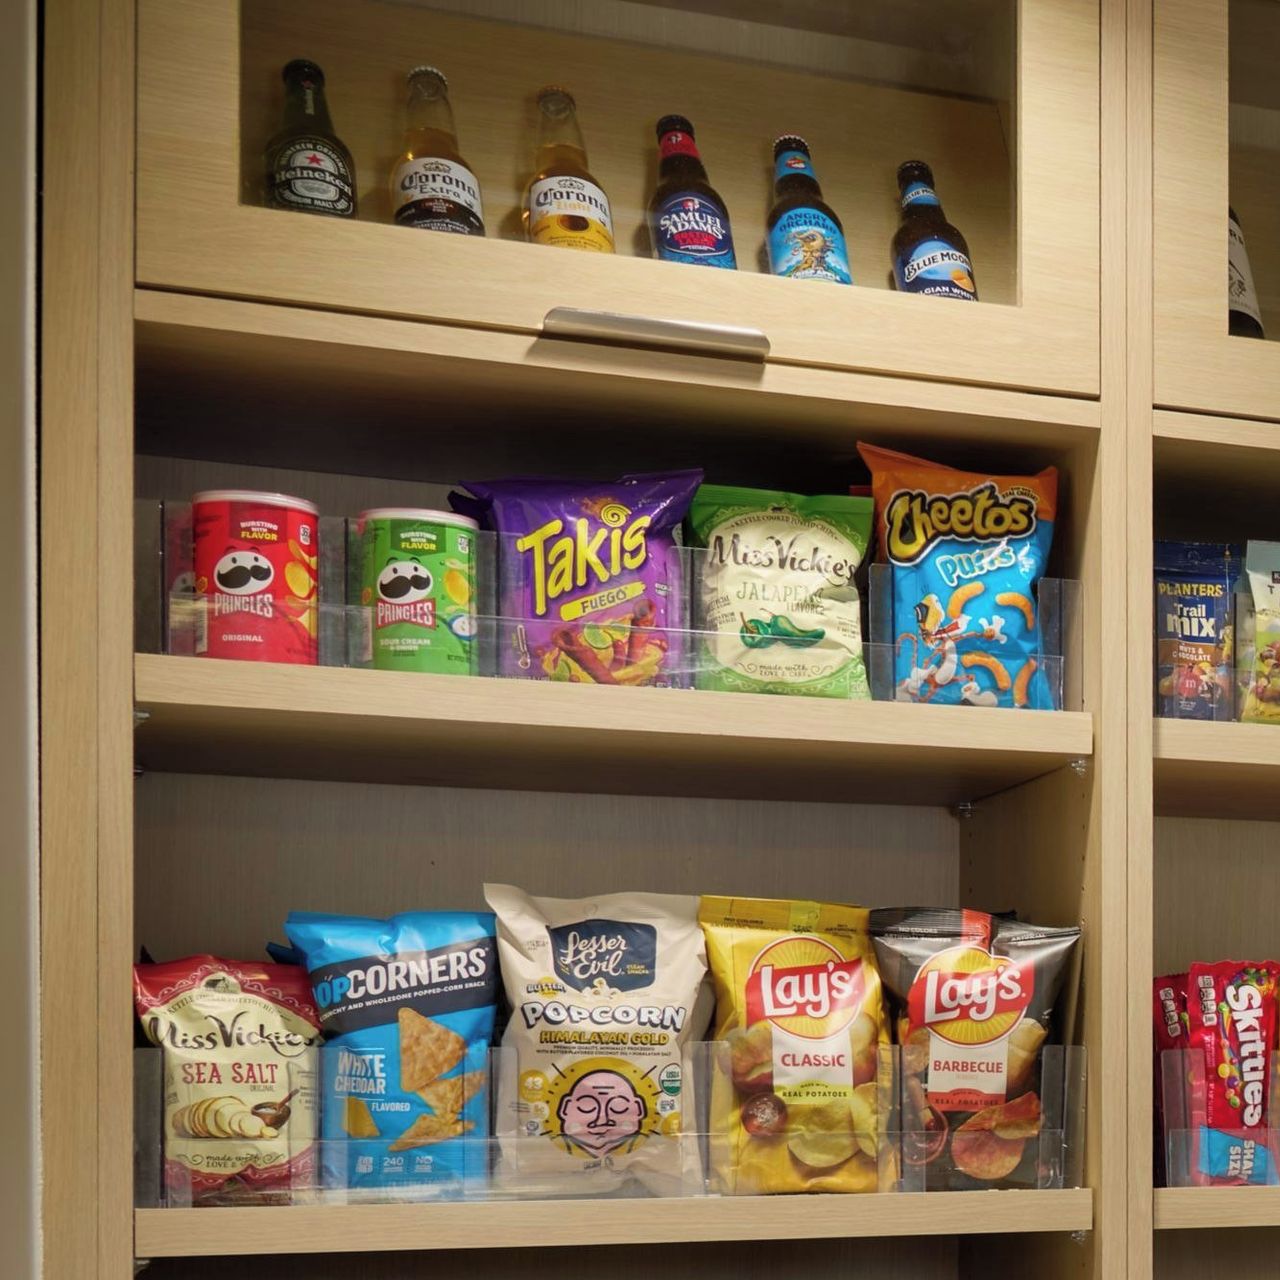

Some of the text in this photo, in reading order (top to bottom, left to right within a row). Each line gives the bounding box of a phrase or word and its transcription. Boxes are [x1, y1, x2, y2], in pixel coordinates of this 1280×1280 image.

[401, 170, 478, 200] Corona
[419, 184, 461, 199] Extra
[536, 189, 608, 216] Corona
[660, 210, 726, 234] SAMUEL
[779, 219, 836, 234] ORCHARD
[786, 210, 827, 223] ANGRY
[666, 220, 723, 240] ADAMS
[906, 256, 940, 281] BLUE
[890, 489, 1028, 558] Cheetos
[710, 533, 774, 568] Miss
[518, 515, 652, 615] Takis
[582, 588, 627, 614] FUEGO
[1159, 584, 1223, 596] PLANTERS
[214, 593, 273, 616] PRINGLES
[377, 602, 432, 626] PRINGLES
[1174, 604, 1206, 617] Trail
[1167, 615, 1216, 638] mix
[222, 634, 263, 643] ORIGINAL
[574, 950, 621, 979] Evil
[365, 985, 463, 1006] WHOLESOME POPPED-CORN
[761, 961, 850, 1017] Lay's
[925, 966, 1021, 1023] Lay's
[521, 1002, 686, 1032] POPCORN
[540, 1031, 668, 1045] HIMALAYAN GOLD
[781, 1054, 845, 1067] CLASSIC
[933, 1061, 1003, 1073] BARBECUE
[1227, 984, 1263, 1127] Skittles
[182, 1063, 278, 1084] SEA SALT
[372, 1103, 410, 1111] FLAVORED
